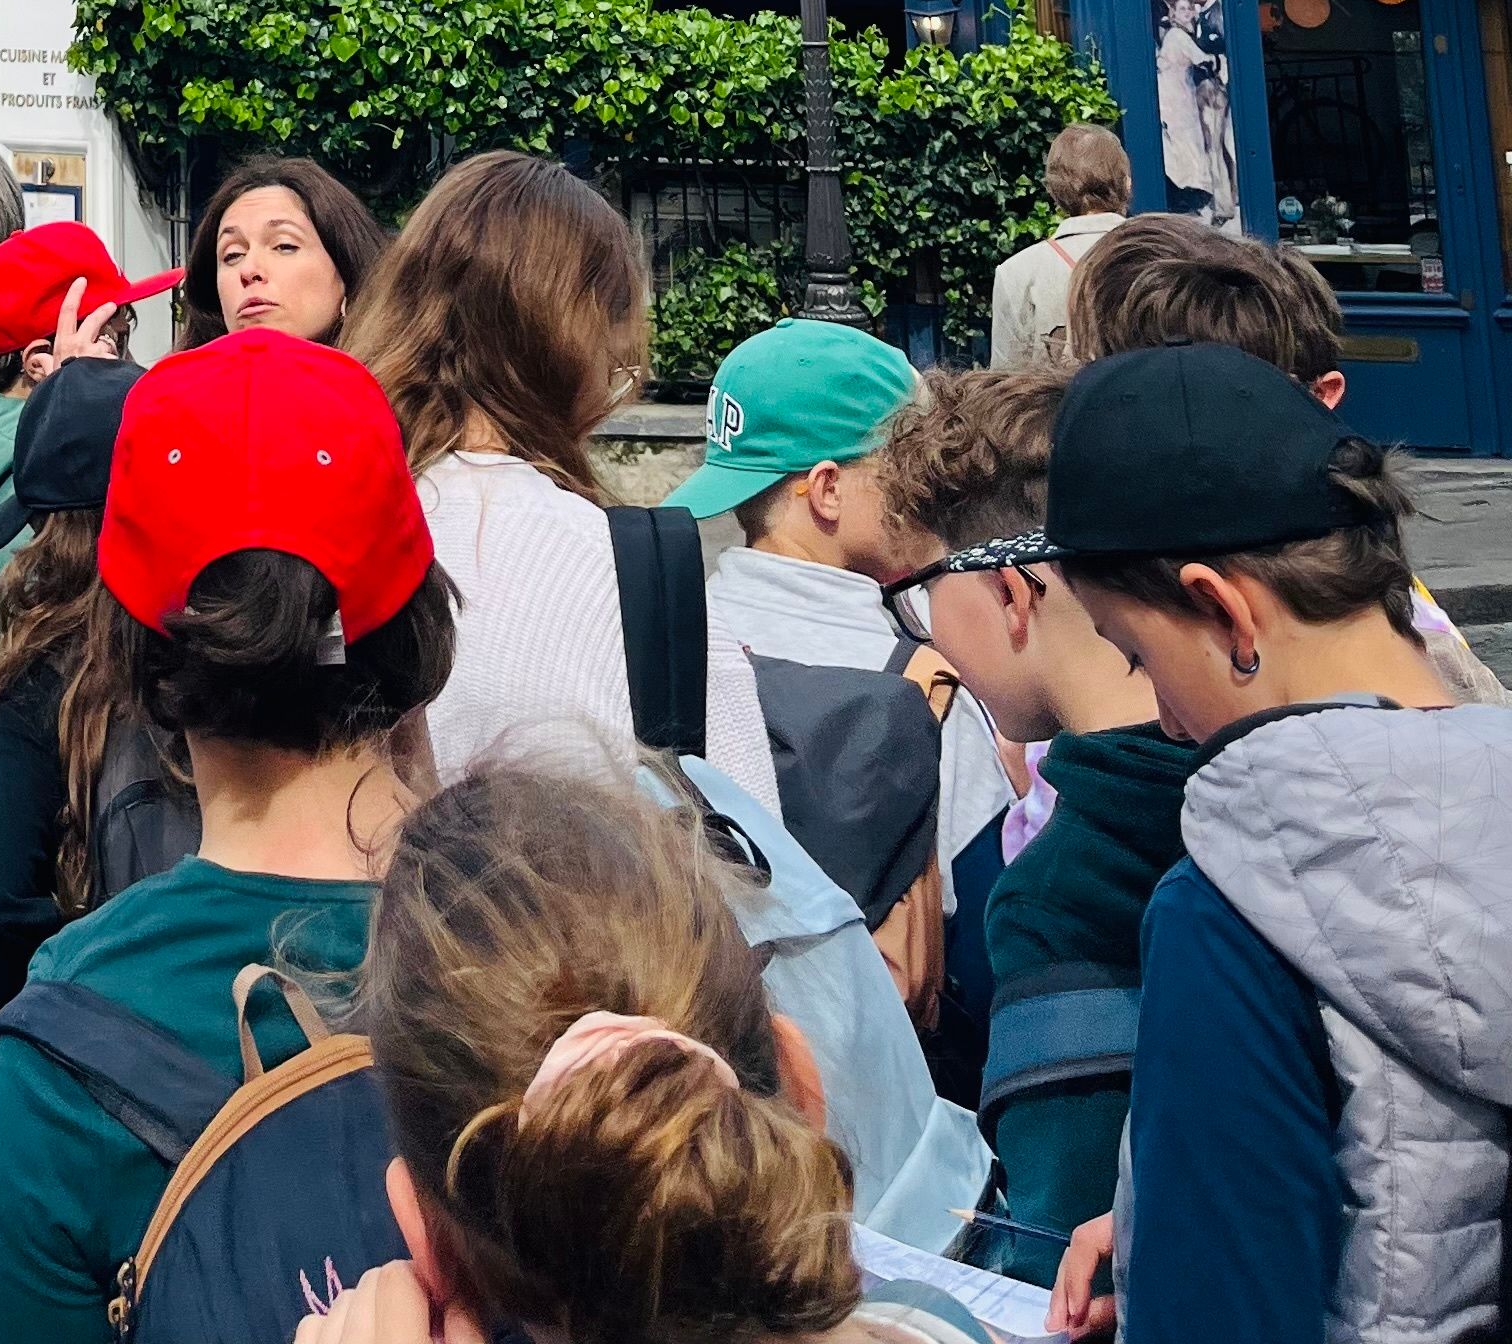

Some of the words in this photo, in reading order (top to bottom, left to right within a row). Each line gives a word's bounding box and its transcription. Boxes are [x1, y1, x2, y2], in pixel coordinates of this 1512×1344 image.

[0, 48, 48, 64] CUISINE
[42, 72, 56, 86] ET
[1, 92, 62, 109] PRODUITS
[65, 95, 100, 110] FRAIS
